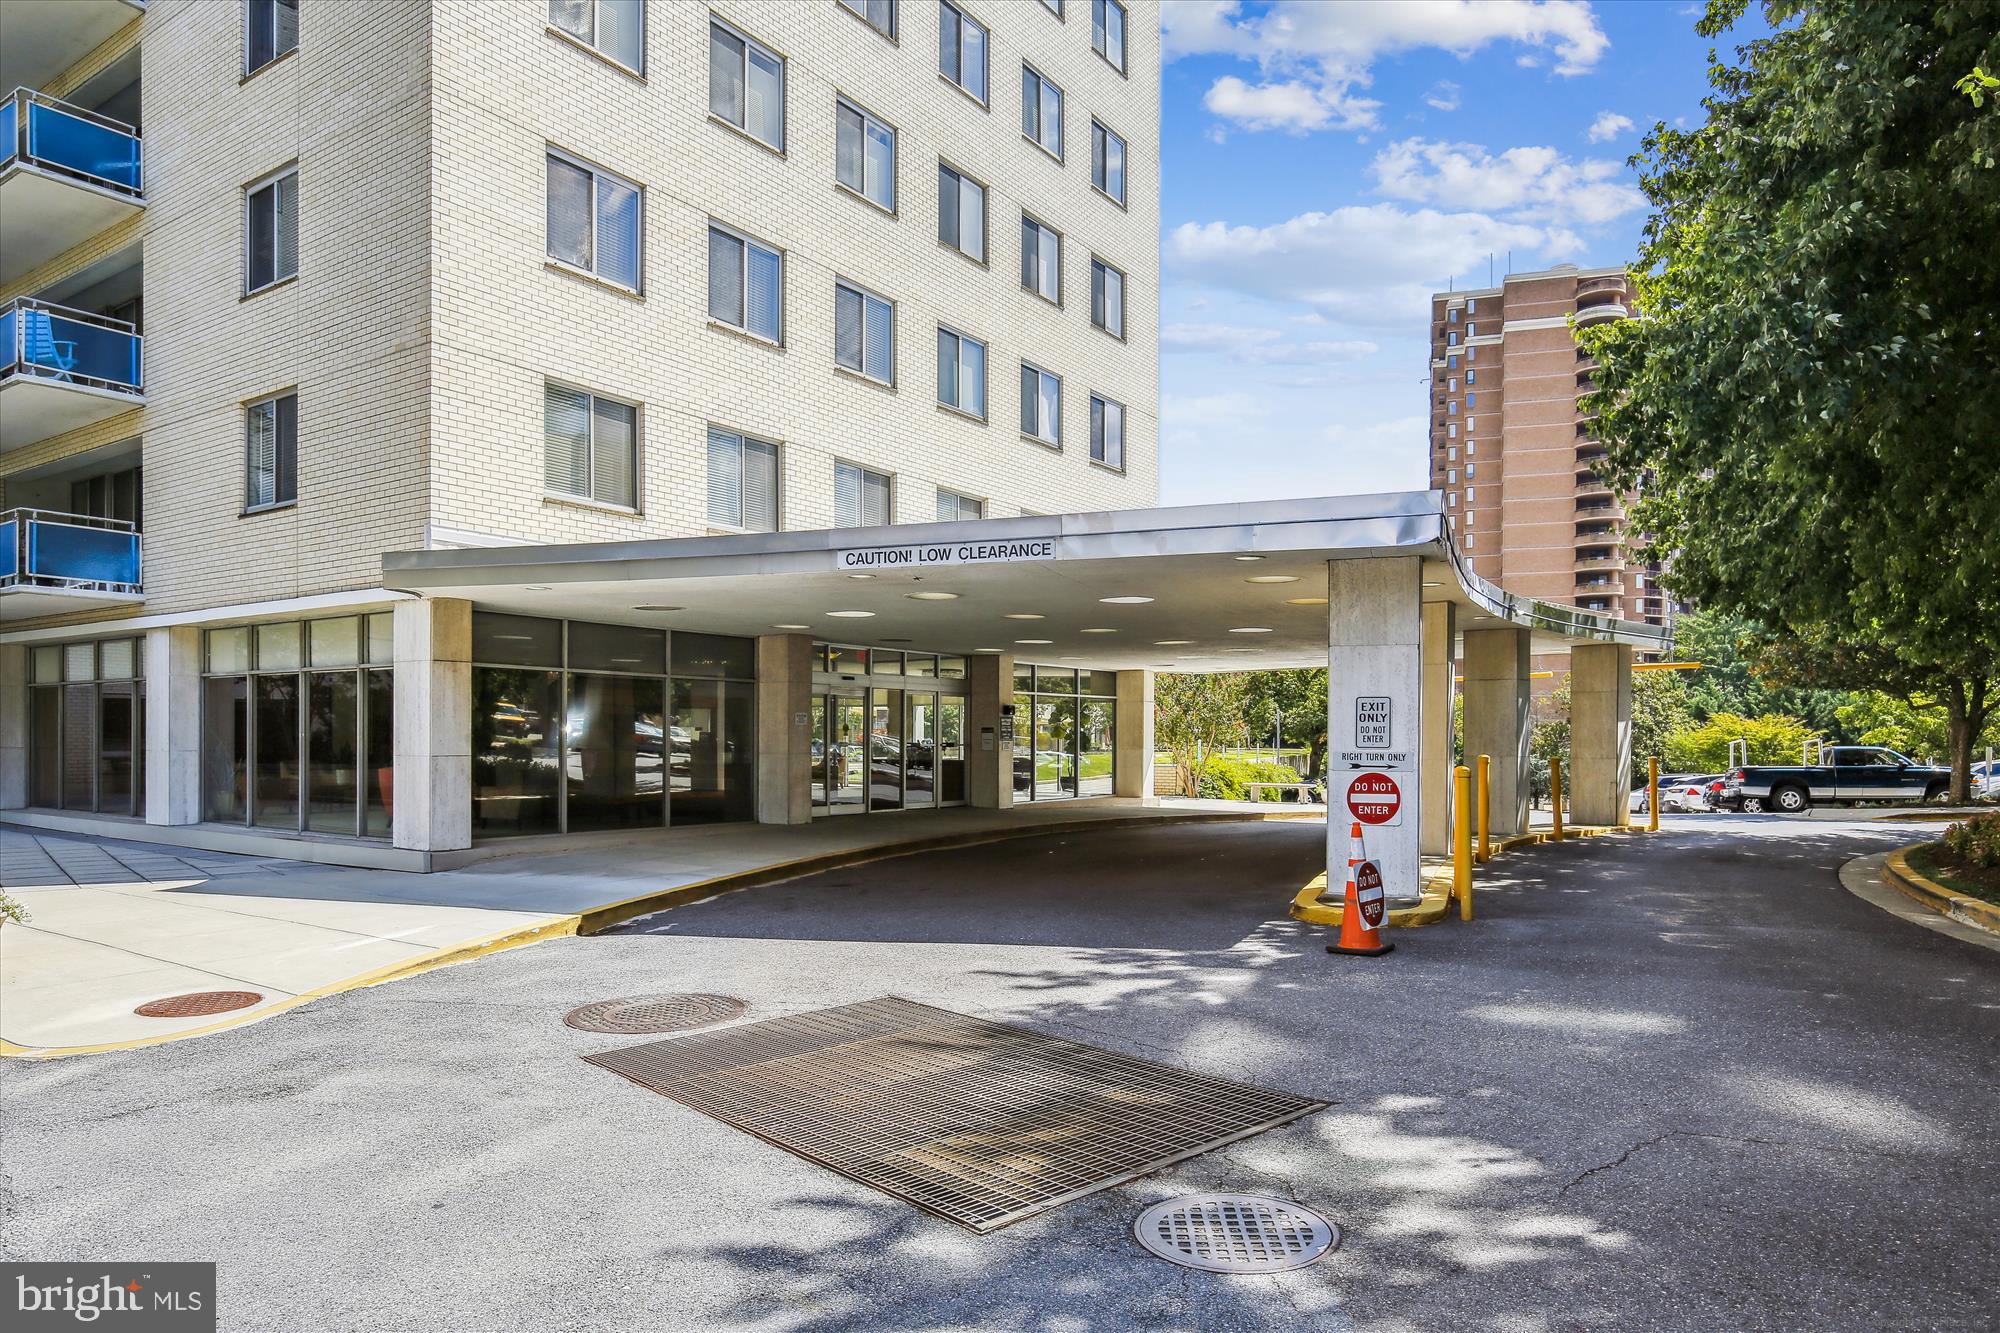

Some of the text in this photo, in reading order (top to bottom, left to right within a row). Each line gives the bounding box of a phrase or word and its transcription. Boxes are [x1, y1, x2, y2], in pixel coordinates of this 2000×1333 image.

[845, 543, 1051, 565] CAUTION! LOW CLEARANCE
[1361, 702, 1385, 711] EXIT
[1359, 713, 1387, 722] ONLY
[1362, 735, 1384, 743] ENTER
[1366, 753, 1384, 761] TURN
[1388, 753, 1406, 761] ONLY
[1354, 783, 1393, 791] DO NOT
[1358, 806, 1389, 814] ENTER
[1359, 873, 1378, 887] DO NOT
[1364, 902, 1382, 916] ENTER
